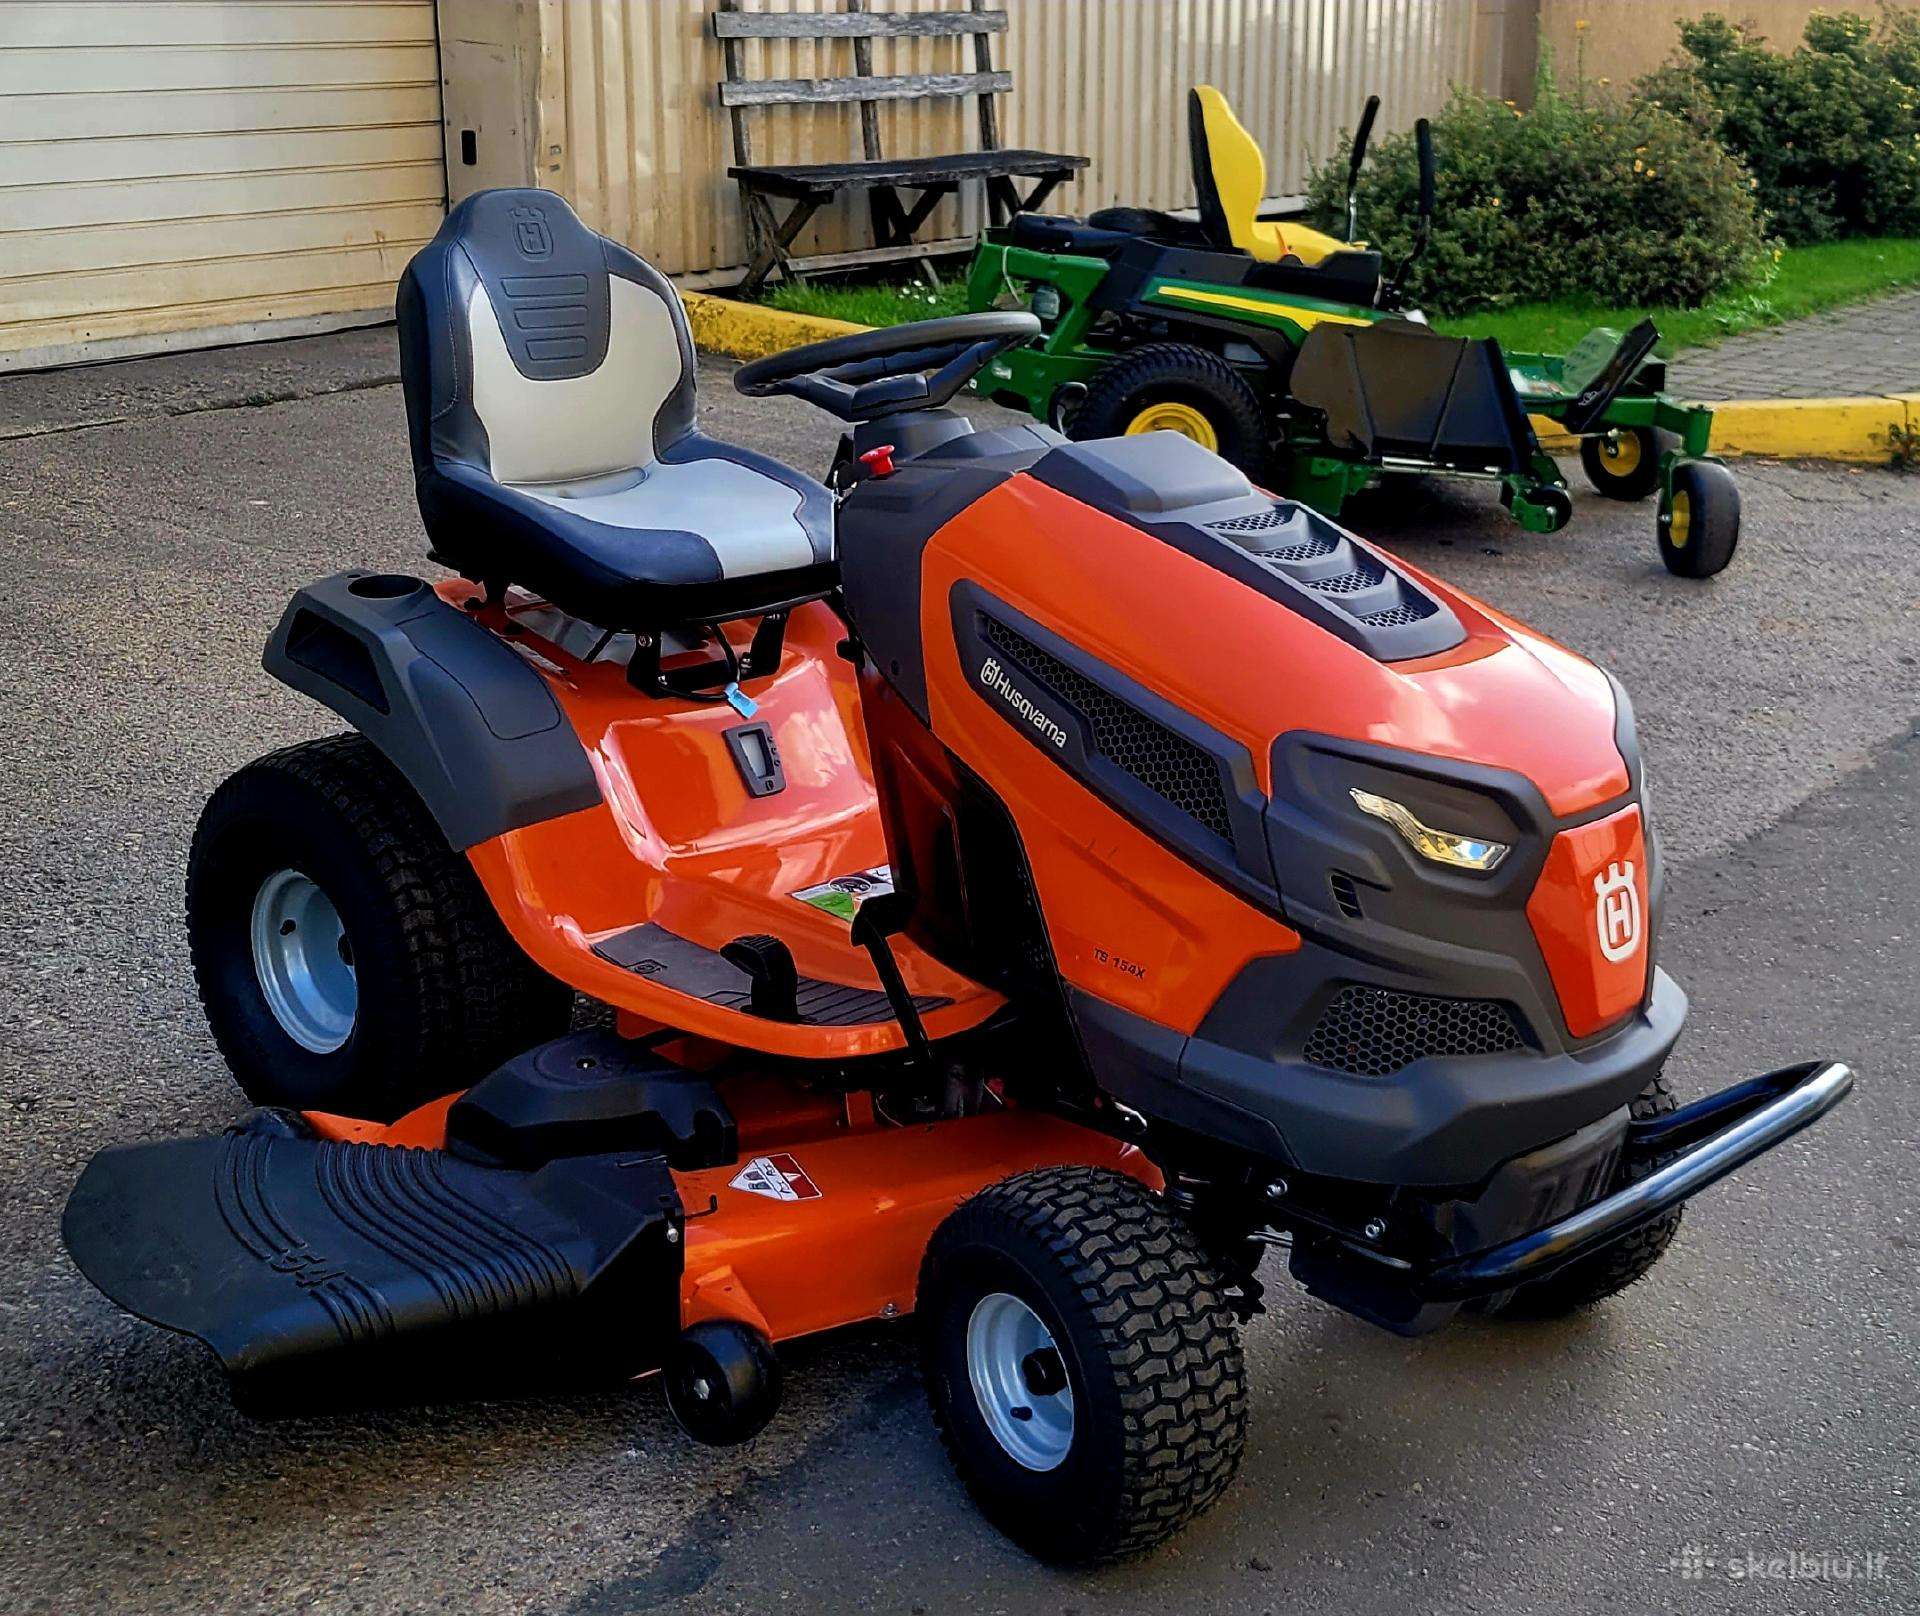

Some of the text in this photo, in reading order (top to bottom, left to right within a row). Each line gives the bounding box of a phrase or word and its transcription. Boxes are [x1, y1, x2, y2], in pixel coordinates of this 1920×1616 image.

[993, 672, 1067, 748] Husqvarna
[1094, 947, 1146, 979] TS 154X
